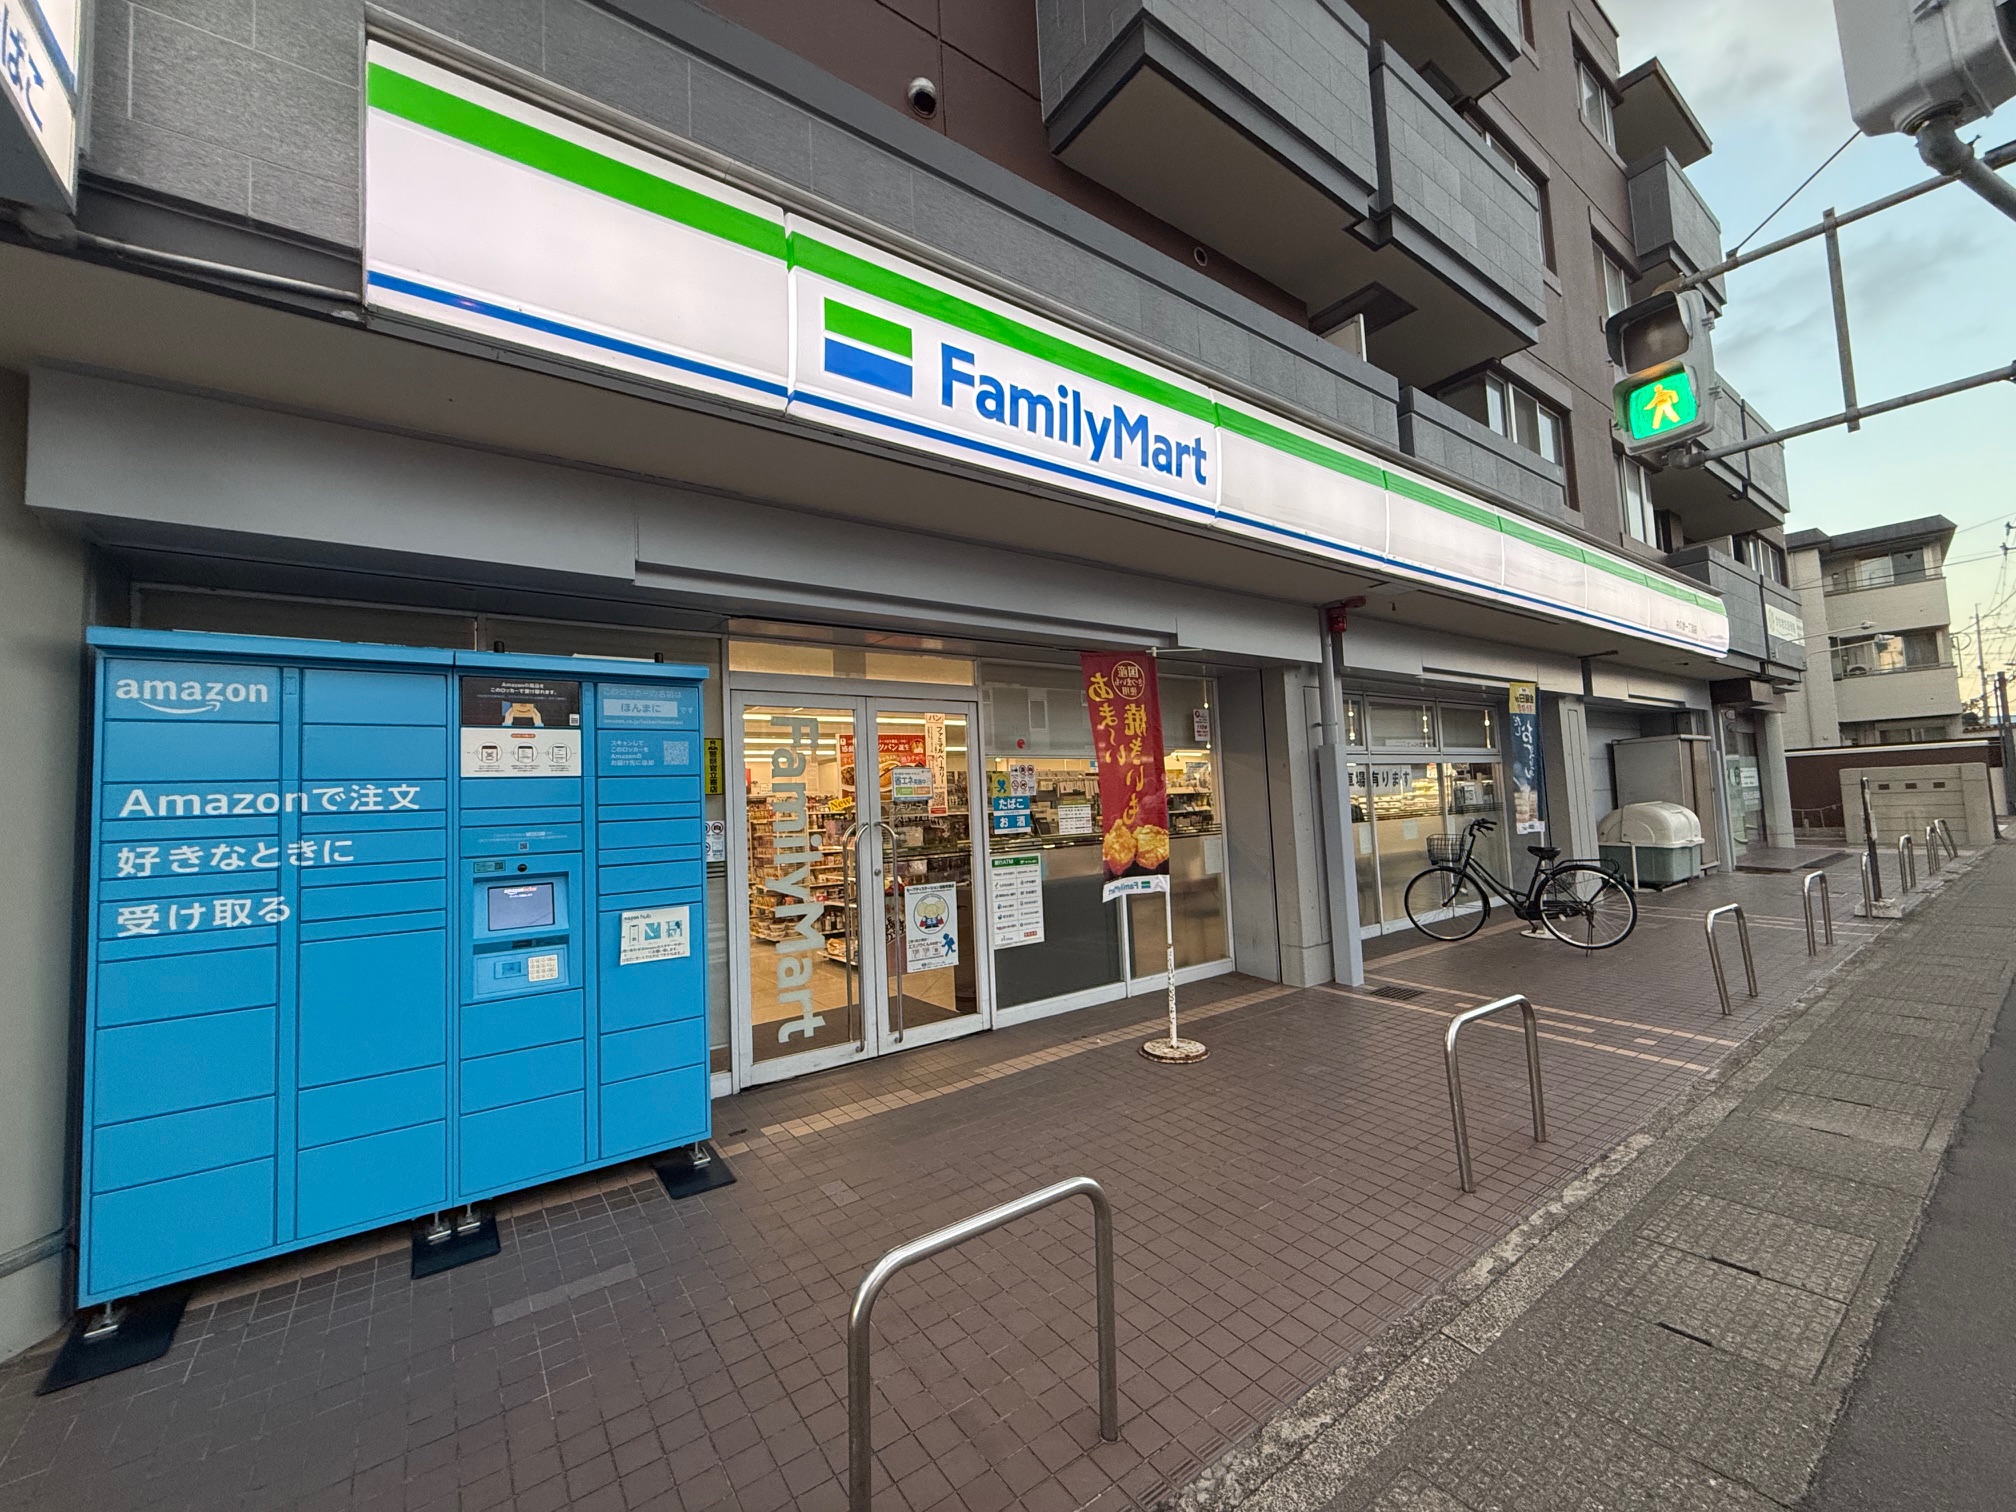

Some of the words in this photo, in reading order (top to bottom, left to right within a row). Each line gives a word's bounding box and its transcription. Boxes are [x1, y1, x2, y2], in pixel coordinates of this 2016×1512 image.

[940, 342, 1208, 486] FamilyMart
[115, 677, 269, 706] amazon
[620, 703, 662, 713] ほんまに
[118, 783, 421, 818] Amazonで注文
[831, 798, 851, 810] New
[998, 798, 1025, 810] たばこ
[116, 839, 355, 878] 好きなときに
[765, 716, 826, 1043] FamilyMart
[116, 896, 291, 938] 受け取る
